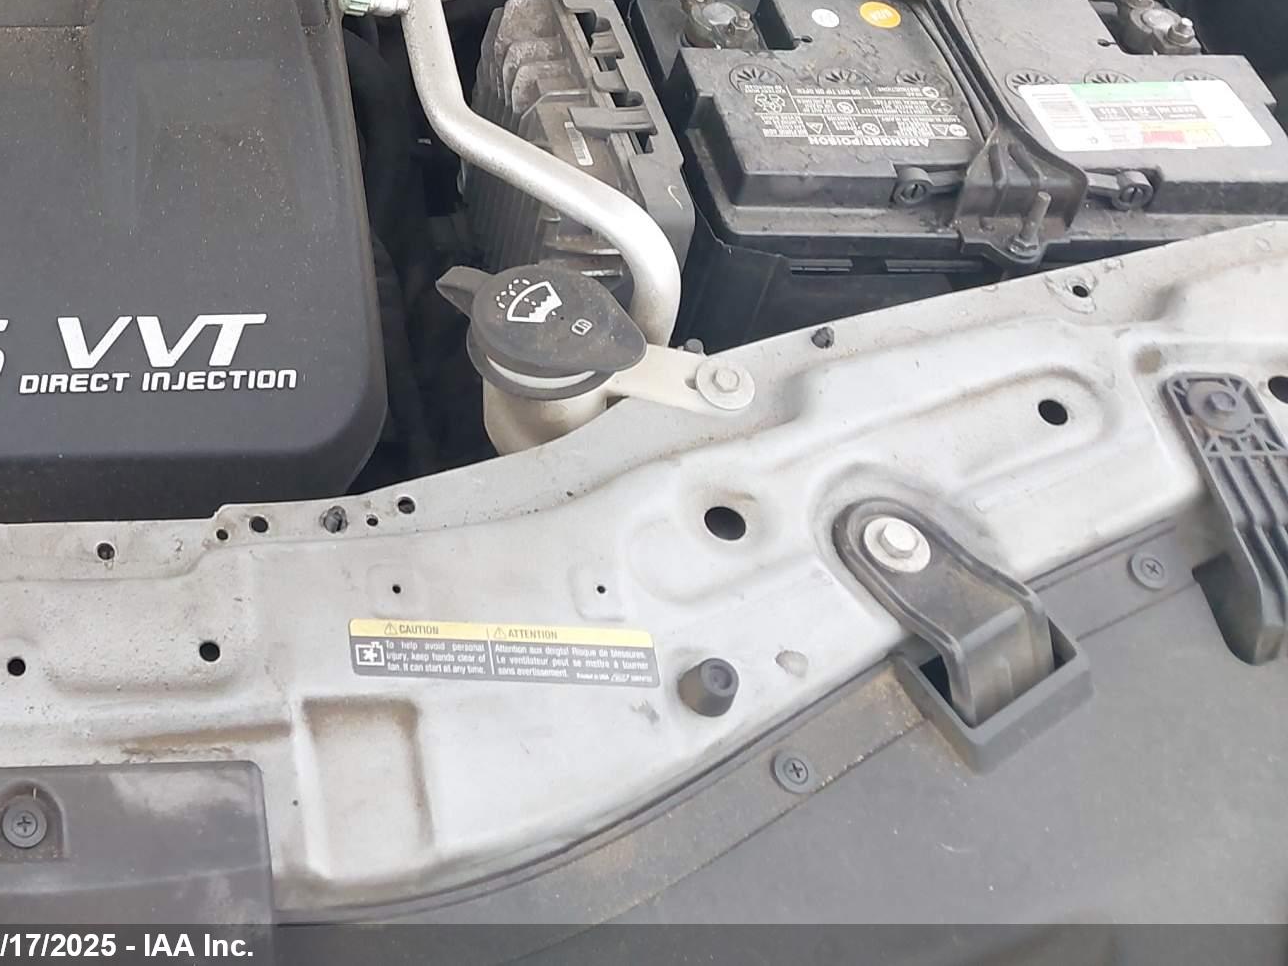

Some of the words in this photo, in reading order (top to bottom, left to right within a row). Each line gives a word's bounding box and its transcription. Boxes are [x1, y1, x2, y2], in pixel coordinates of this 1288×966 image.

[57, 313, 268, 370] VVT
[18, 371, 131, 394] DIRECT
[141, 368, 297, 392] INJECTION
[399, 625, 439, 635] CAUTION
[508, 629, 558, 640] ATTENTION
[386, 640, 394, 648] To
[401, 641, 418, 650] help
[425, 642, 445, 651] avoid
[452, 644, 485, 652] personal
[495, 644, 527, 654] Attention
[572, 647, 596, 658] Risque
[599, 649, 608, 658] de
[412, 653, 429, 662] keep
[432, 654, 455, 662] hands
[478, 654, 486, 663] of
[496, 655, 506, 664] Le
[509, 656, 548, 666] ventilateur
[552, 657, 569, 667] peut
[572, 660, 582, 668] se
[622, 661, 649, 669] tourner
[425, 664, 442, 672] start
[443, 665, 452, 673] at
[452, 666, 465, 674] any
[498, 668, 515, 676] sans
